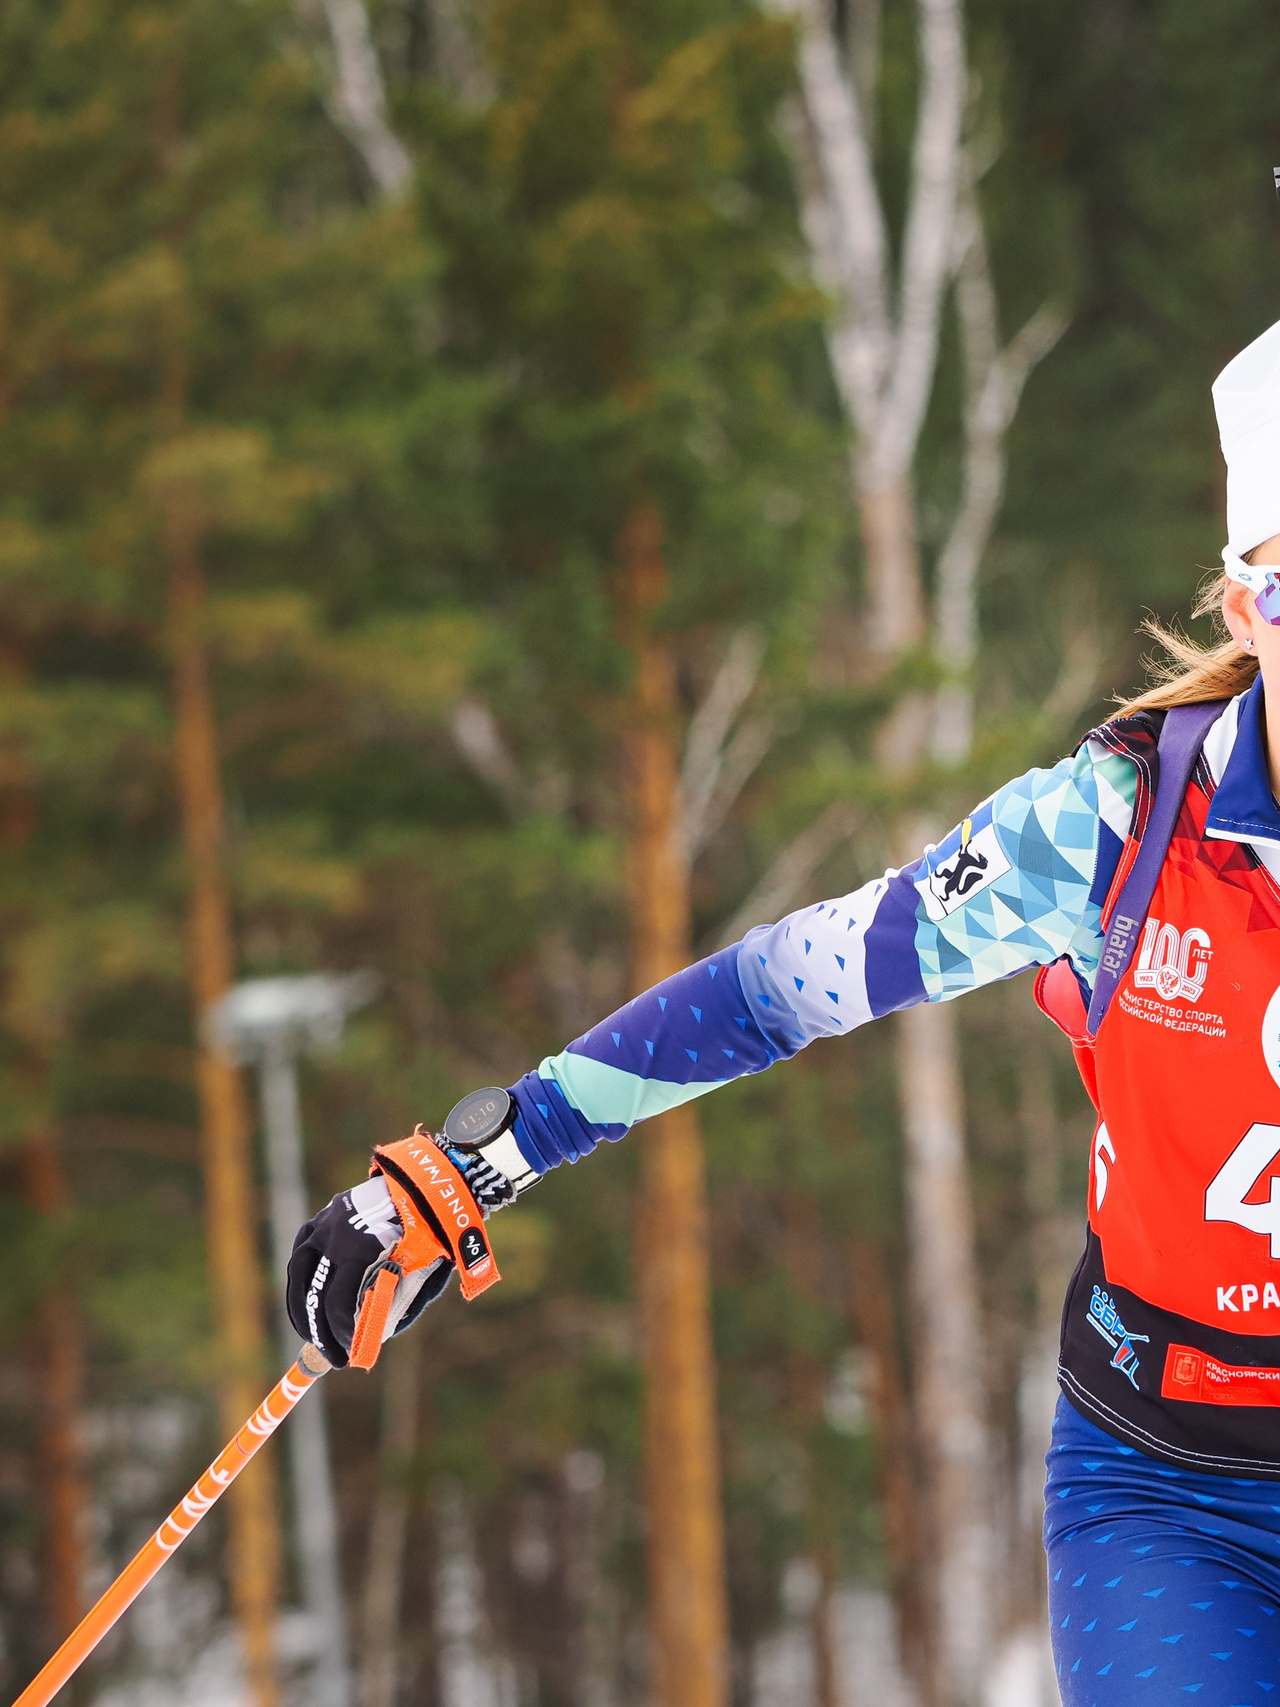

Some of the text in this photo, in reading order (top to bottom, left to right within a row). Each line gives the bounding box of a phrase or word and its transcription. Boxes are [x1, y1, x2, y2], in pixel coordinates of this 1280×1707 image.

[1102, 914, 1139, 979] biatar
[1192, 948, 1214, 960] ЛЕТ
[1181, 984, 1196, 995] 2023
[1185, 1010, 1224, 1025] СПОРТА
[1164, 1018, 1227, 1038] ФЕДЕРАЦИИ
[460, 1101, 496, 1130] 11:10
[408, 1149, 470, 1228] ONE/WAY
[472, 1260, 491, 1277] RIGHT
